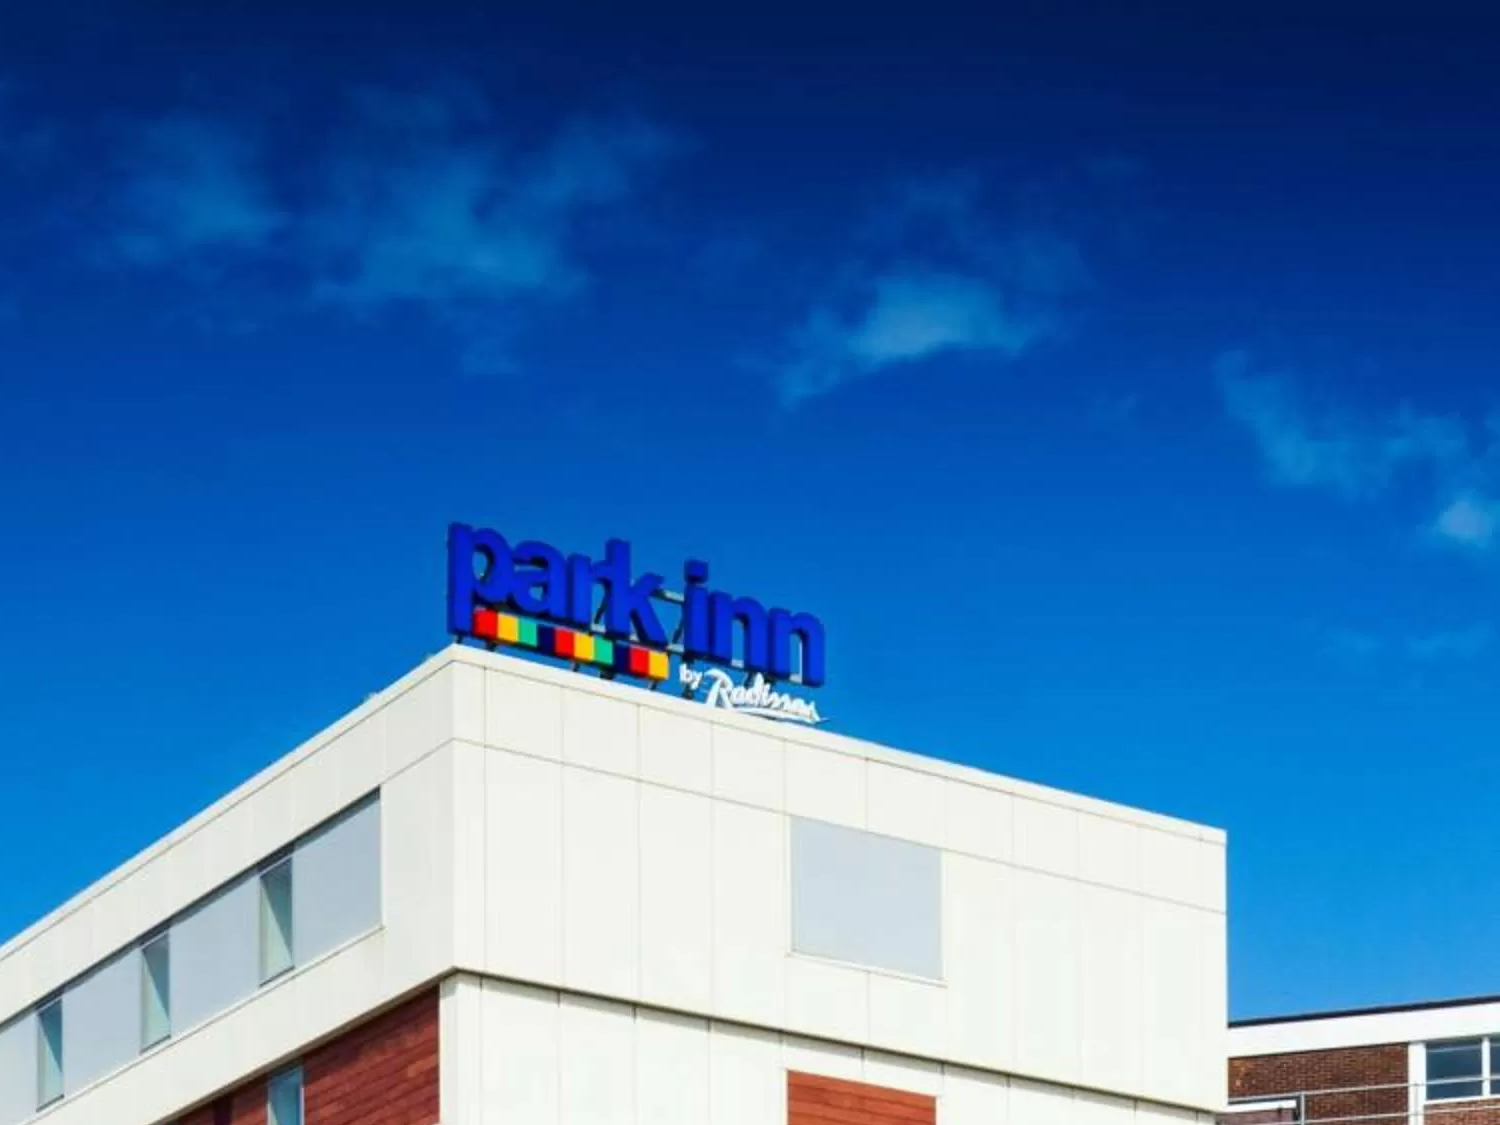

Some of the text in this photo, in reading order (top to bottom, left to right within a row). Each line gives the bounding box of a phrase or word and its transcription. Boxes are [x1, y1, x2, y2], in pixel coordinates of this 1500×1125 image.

[447, 521, 826, 688] park inn
[679, 663, 703, 690] by
